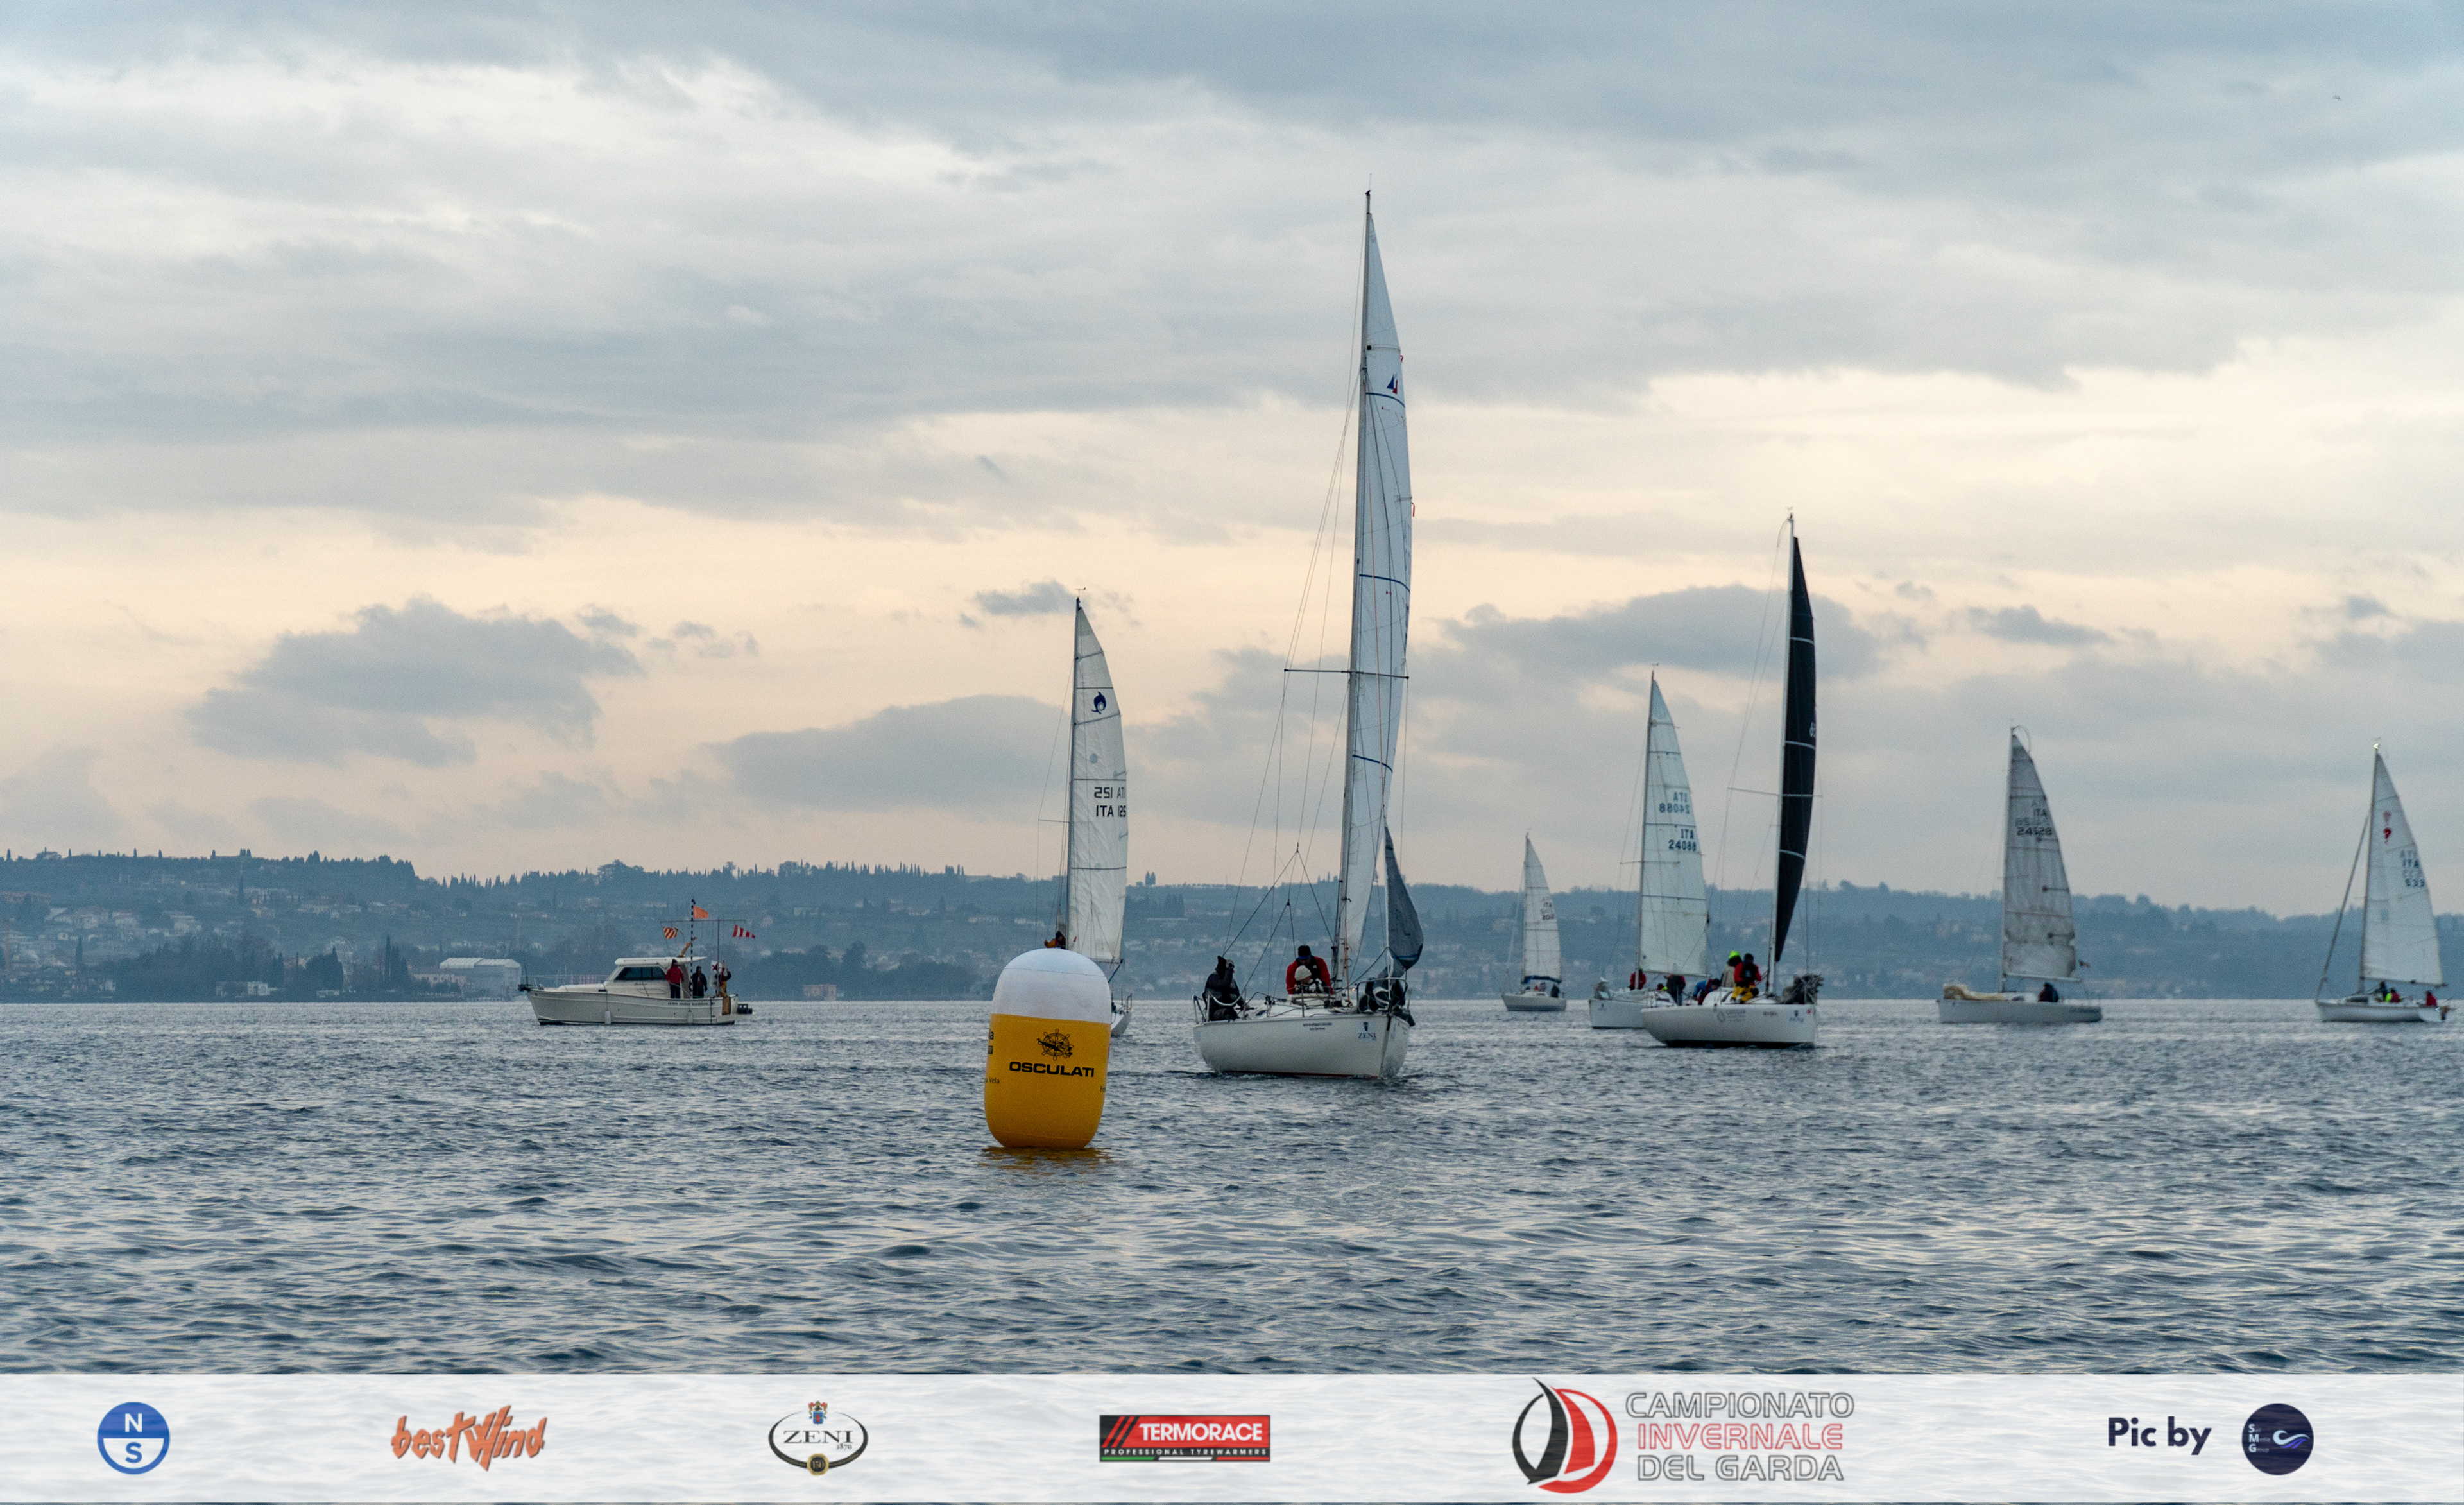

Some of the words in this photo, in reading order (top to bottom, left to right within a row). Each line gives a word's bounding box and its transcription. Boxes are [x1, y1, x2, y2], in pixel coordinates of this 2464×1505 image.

[1096, 805, 1114, 817] ITA
[1681, 829, 1694, 839] ITA
[1009, 1061, 1095, 1077] OSCULATI
